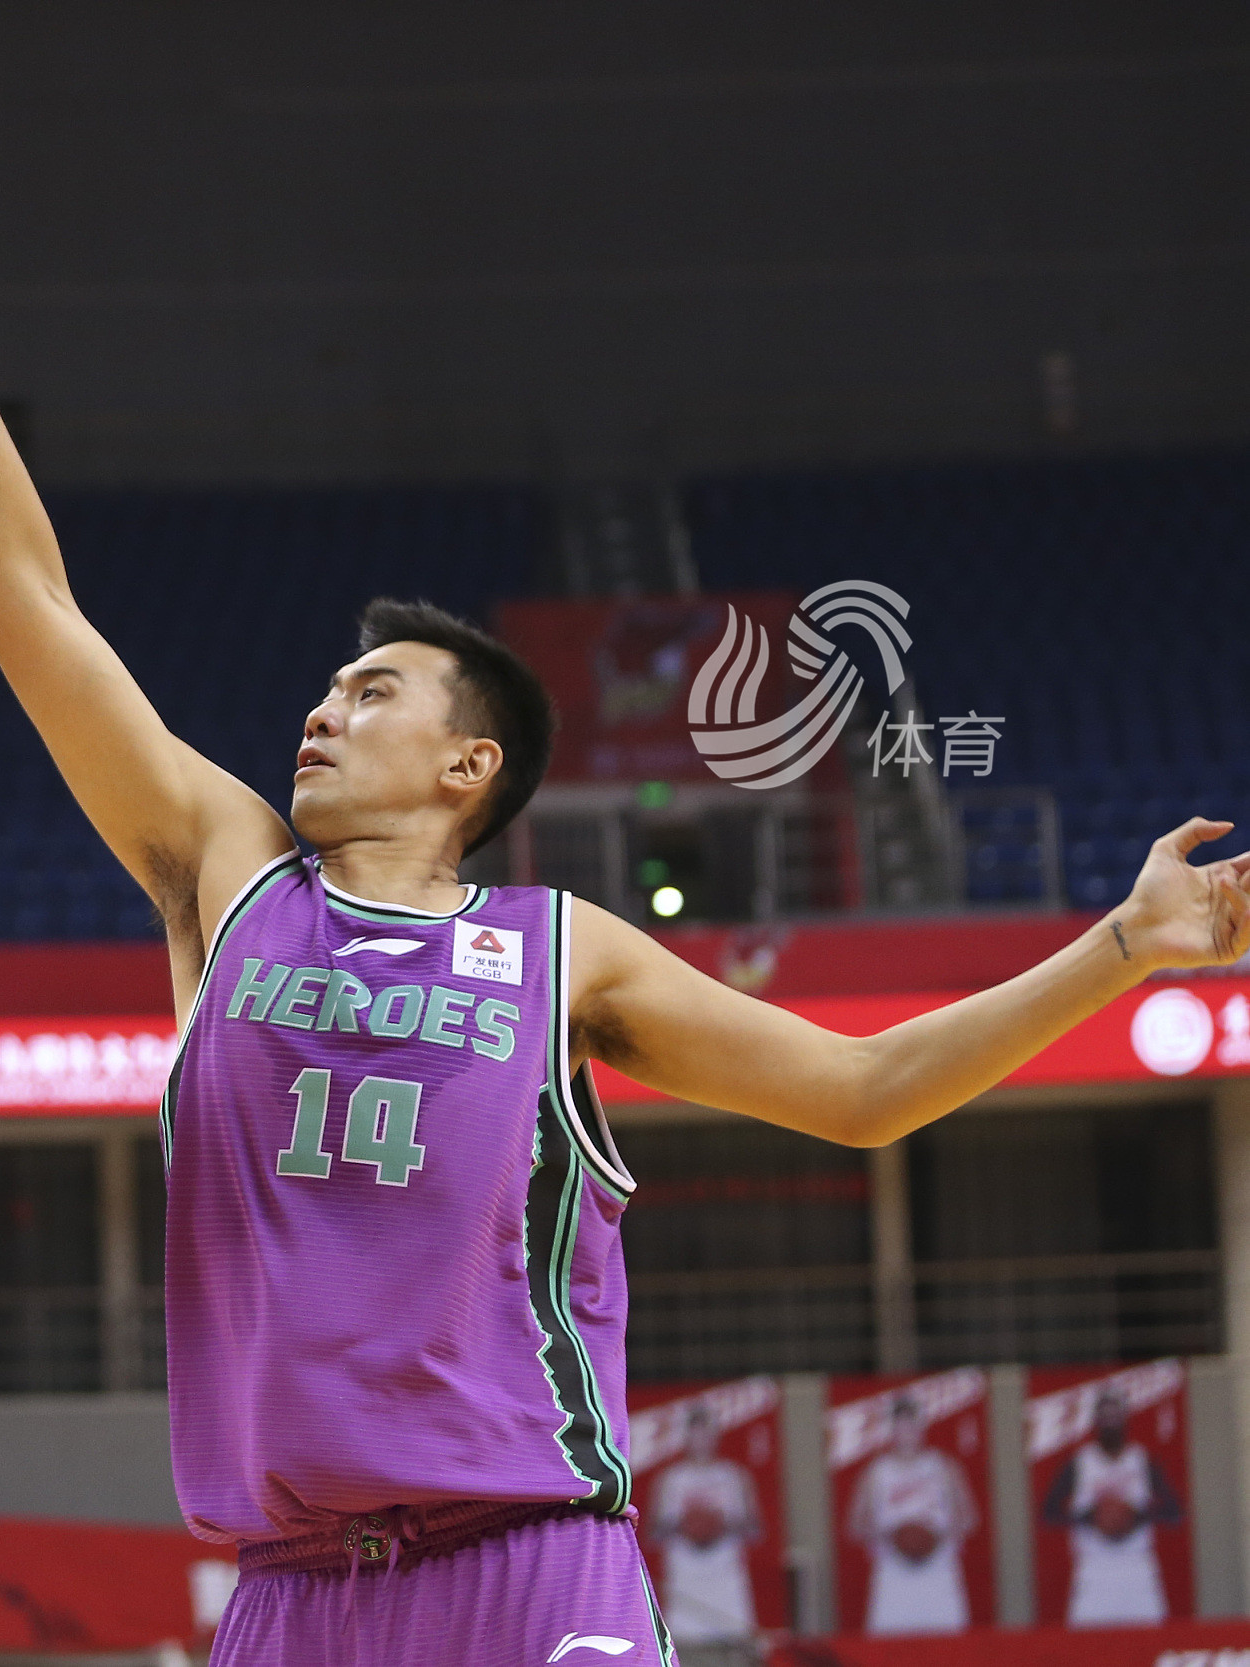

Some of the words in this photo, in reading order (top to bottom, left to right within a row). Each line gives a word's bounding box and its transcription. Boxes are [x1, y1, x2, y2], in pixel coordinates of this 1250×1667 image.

[463, 955, 512, 970] 广发银行
[472, 966, 502, 979] CGB
[225, 958, 521, 1063] HEROES
[276, 1068, 426, 1188] 14
